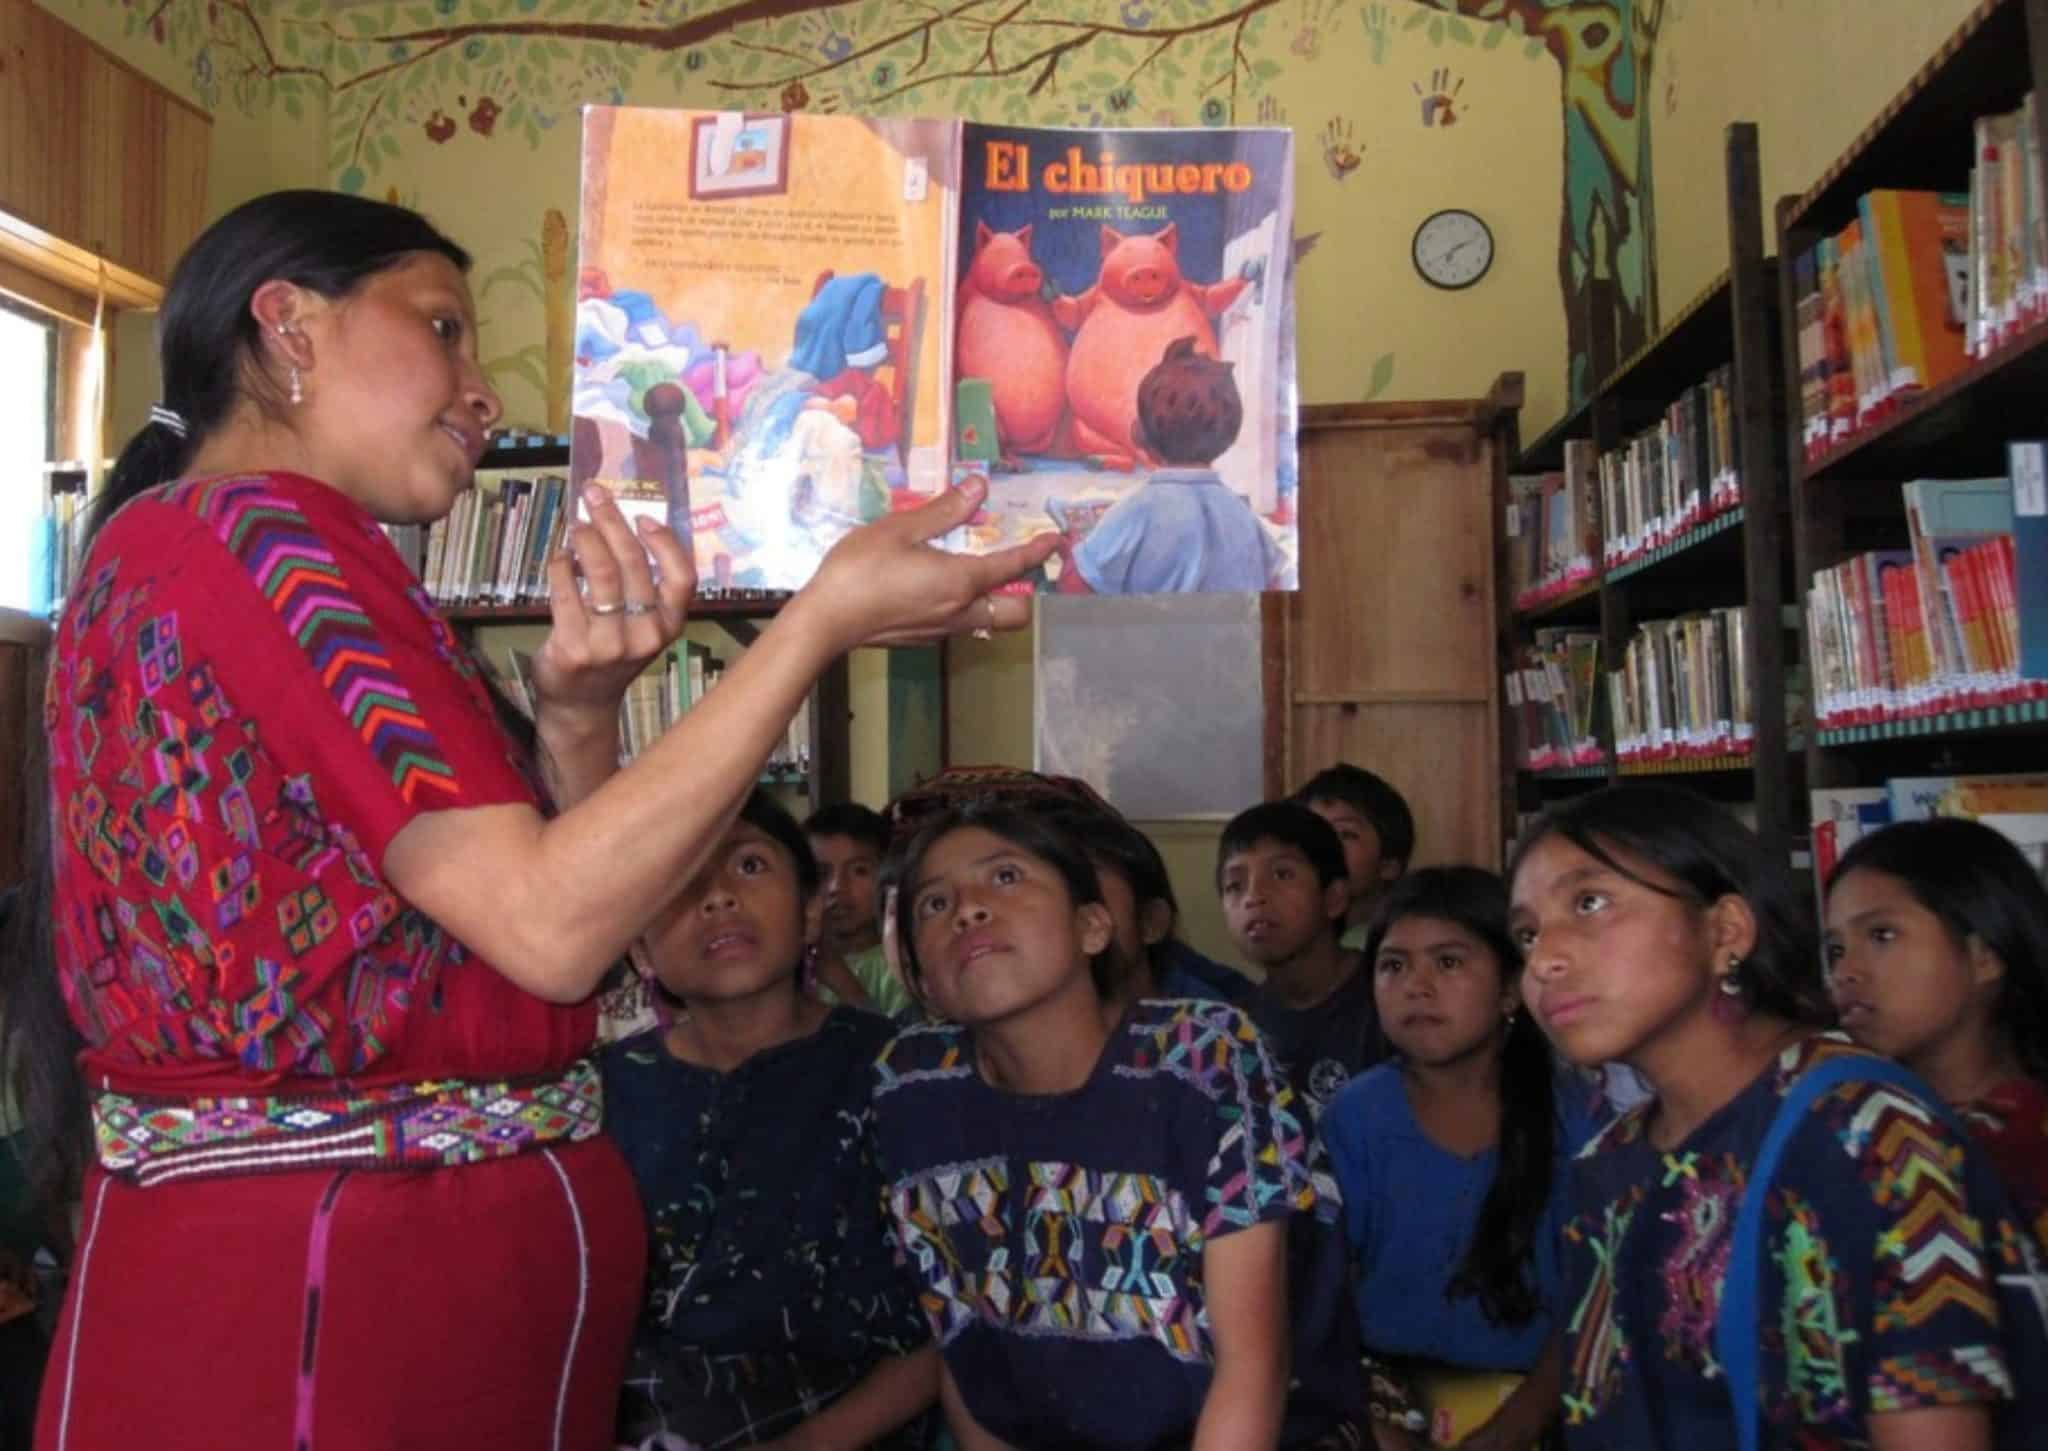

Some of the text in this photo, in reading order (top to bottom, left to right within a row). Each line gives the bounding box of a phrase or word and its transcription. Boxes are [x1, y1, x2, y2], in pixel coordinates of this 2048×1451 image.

[985, 140, 1253, 204] El chiquero
[1048, 208, 1070, 221] por
[1072, 206, 1112, 220] MARK
